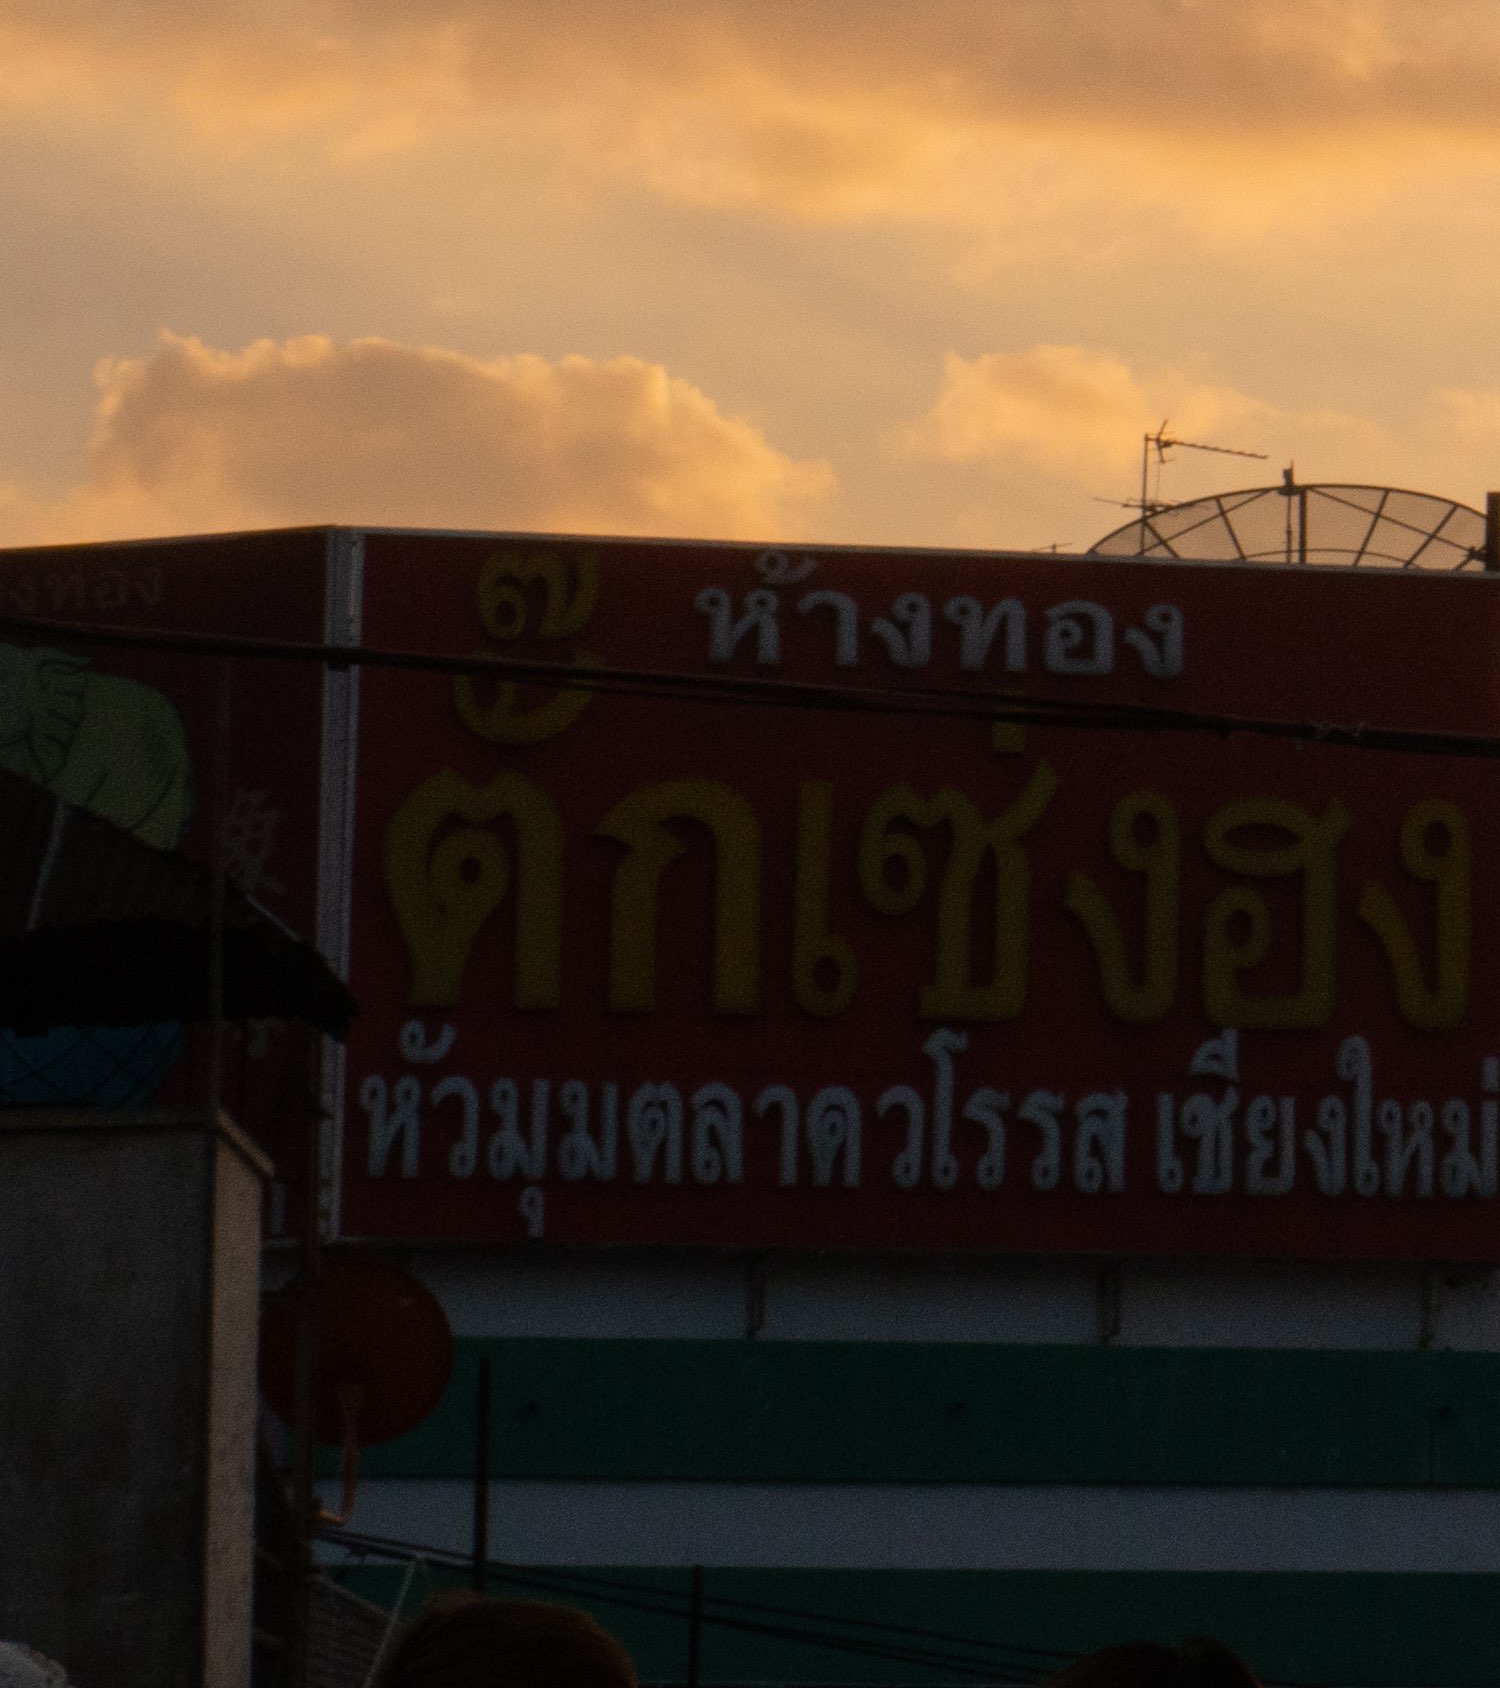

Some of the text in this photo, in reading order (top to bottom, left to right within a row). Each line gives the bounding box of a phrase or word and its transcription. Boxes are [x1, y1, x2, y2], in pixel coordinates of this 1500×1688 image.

[694, 549, 1184, 678] ห้างทอง
[384, 548, 1472, 1026] ตั๊กเซ่งฮง
